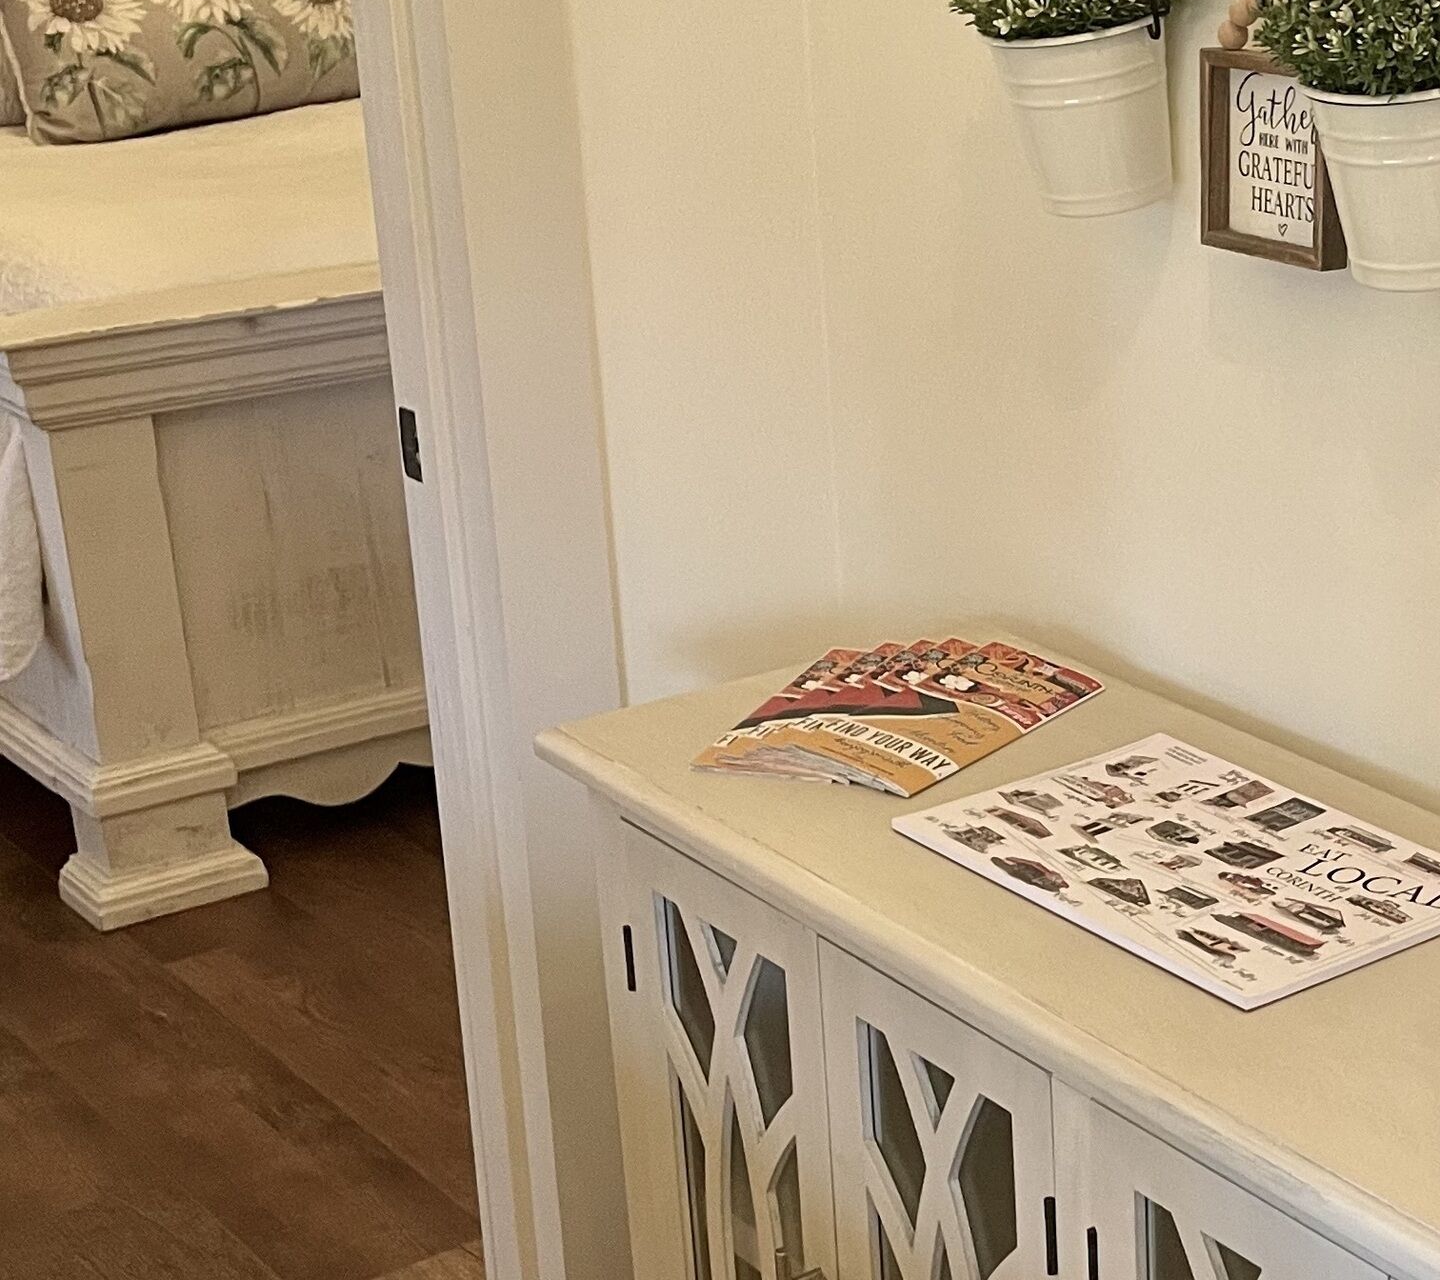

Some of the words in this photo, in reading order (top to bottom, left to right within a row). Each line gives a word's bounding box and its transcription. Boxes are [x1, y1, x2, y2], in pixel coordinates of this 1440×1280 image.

[1258, 132, 1280, 150] HERE
[1285, 137, 1309, 155] WITH
[1238, 149, 1315, 190] GRATEFU
[1251, 184, 1315, 223] HEARTS
[825, 719, 869, 737] FIND
[868, 730, 910, 754] YOUR
[910, 746, 952, 770] WAY
[1297, 843, 1352, 861] EAT
[1266, 866, 1343, 903] CORINTH
